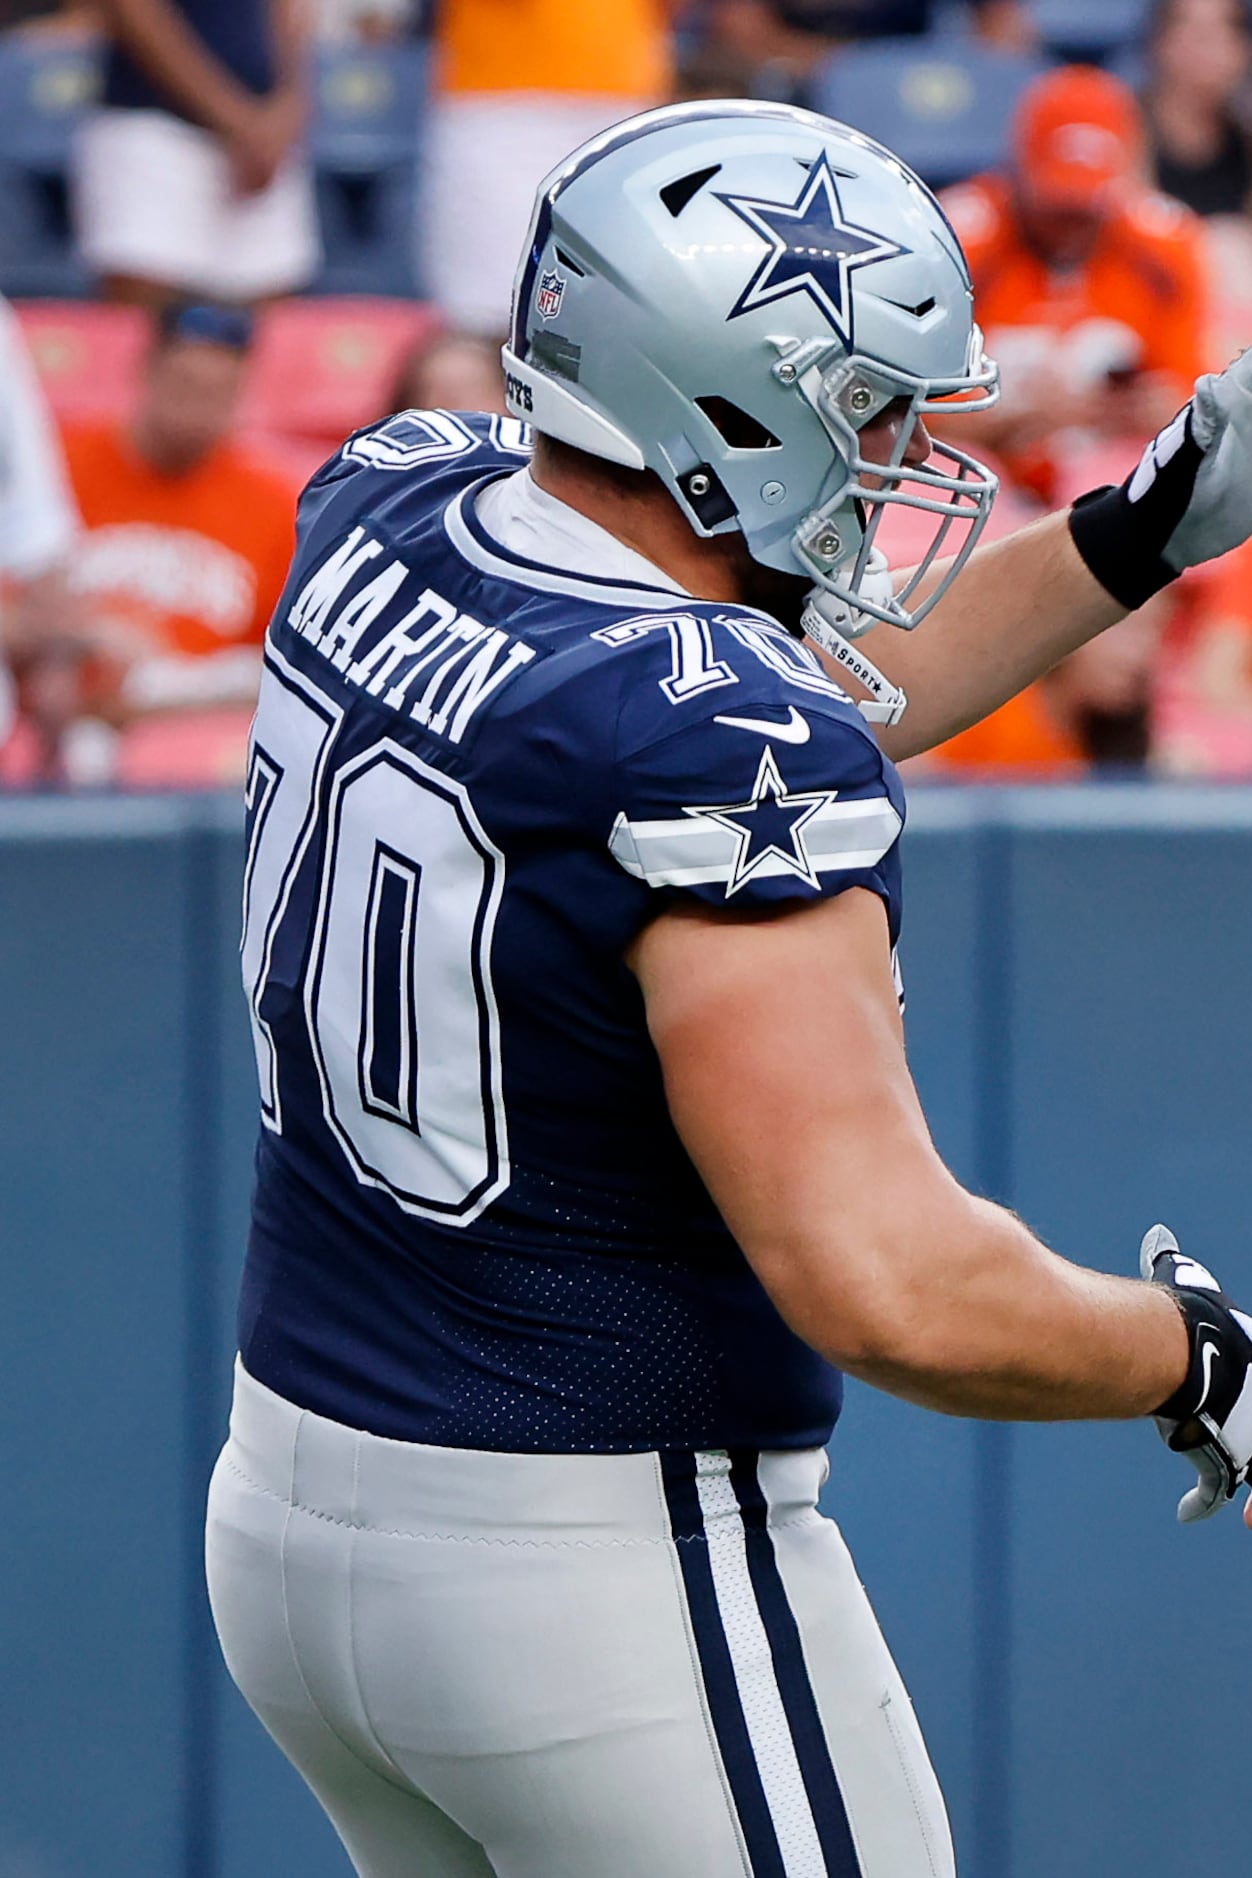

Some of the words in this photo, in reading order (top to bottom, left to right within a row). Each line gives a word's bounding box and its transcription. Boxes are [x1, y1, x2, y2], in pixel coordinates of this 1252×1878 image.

[539, 290, 559, 313] NFL
[287, 525, 537, 744] MARTIN
[590, 612, 853, 704] 70
[240, 625, 511, 1228] 70
